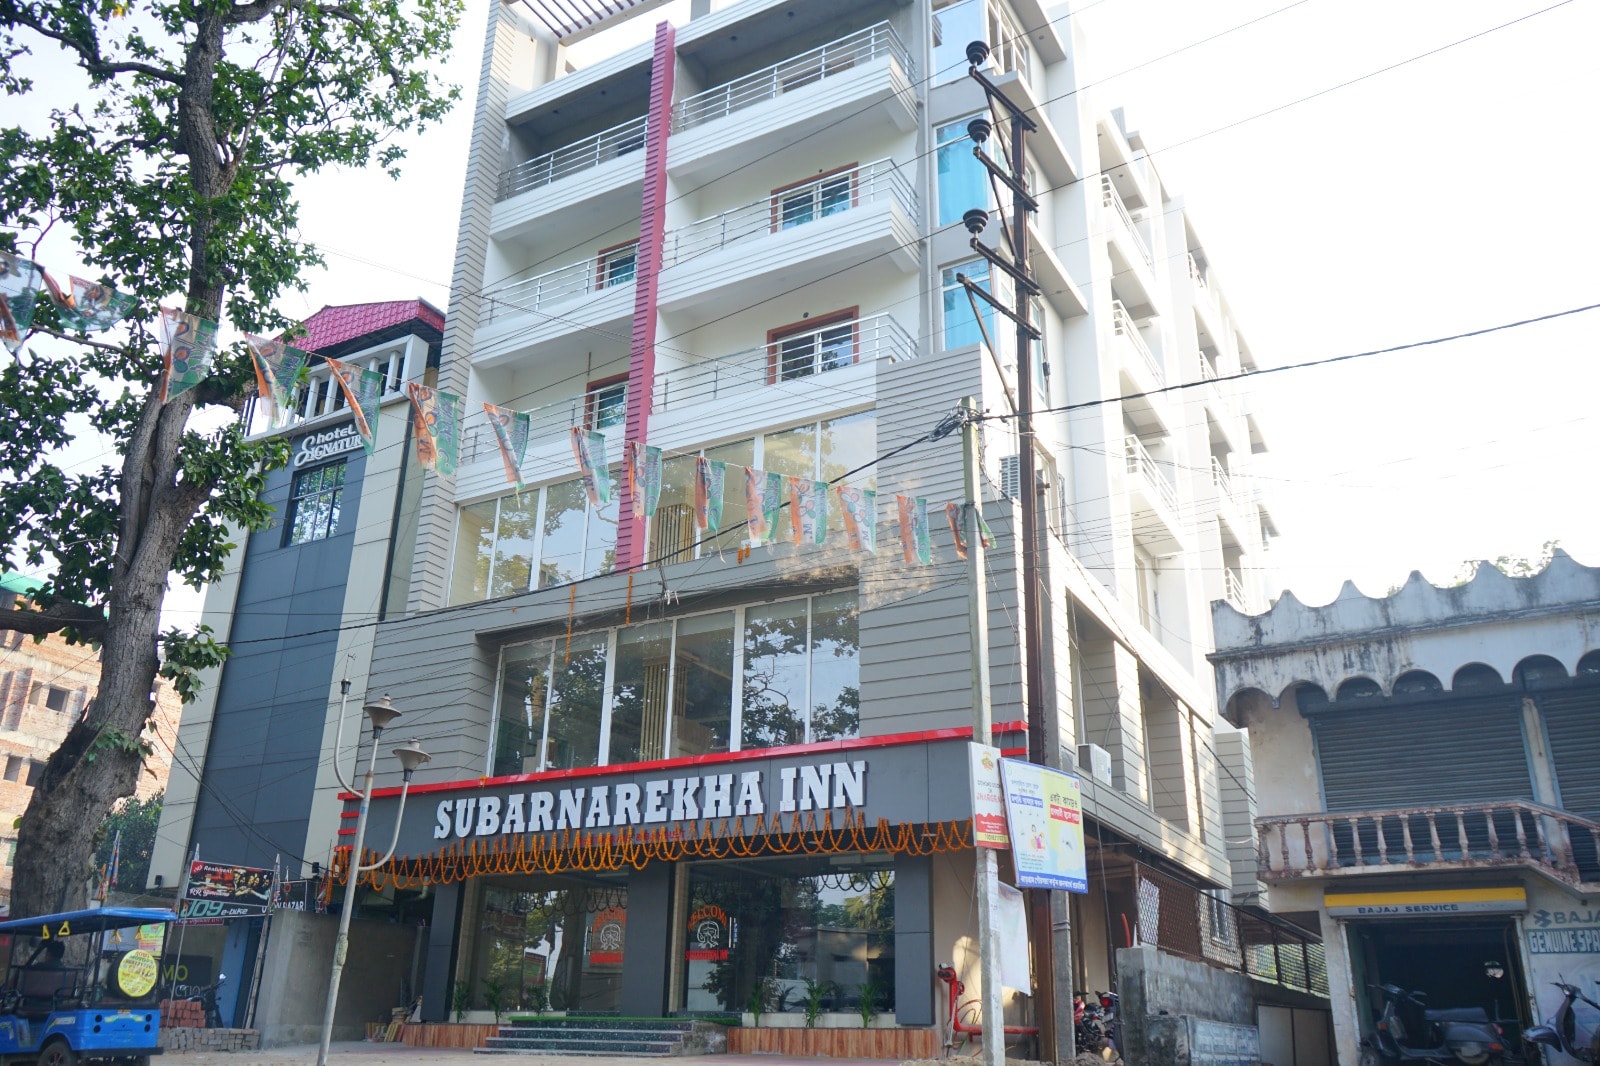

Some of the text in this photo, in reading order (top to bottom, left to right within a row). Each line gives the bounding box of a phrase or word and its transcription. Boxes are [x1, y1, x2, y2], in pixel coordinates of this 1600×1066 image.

[294, 435, 364, 467] SIGNATUR
[434, 760, 867, 839] SUBARNAREKHA INN
[1358, 904, 1459, 914] BAJAJ SERVICE
[1528, 929, 1600, 953] GENUINE SPA
